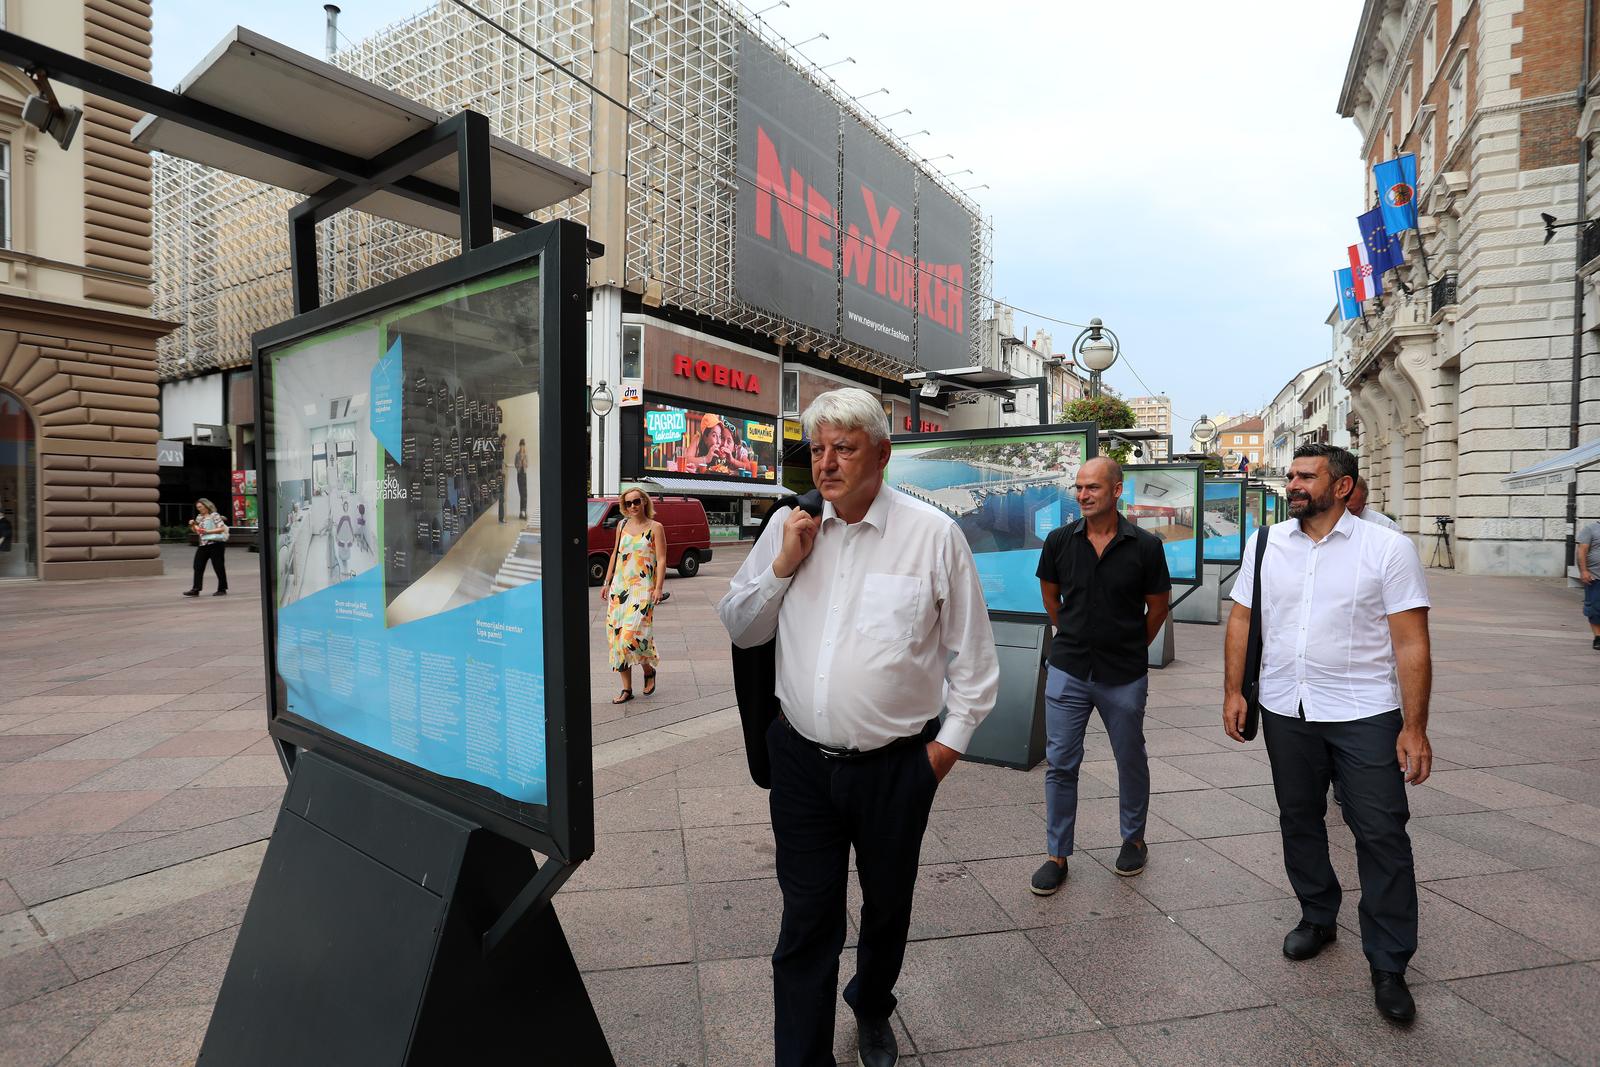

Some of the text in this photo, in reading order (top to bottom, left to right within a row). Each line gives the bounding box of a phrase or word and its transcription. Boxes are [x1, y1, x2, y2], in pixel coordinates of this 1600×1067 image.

[848, 311, 910, 342] www.newyorker.fashion
[674, 354, 761, 394] ROBNA
[624, 386, 638, 397] dm
[649, 414, 684, 431] ZAGRIZI
[905, 416, 942, 432] RJEKA
[749, 427, 773, 438] SUBMARINE
